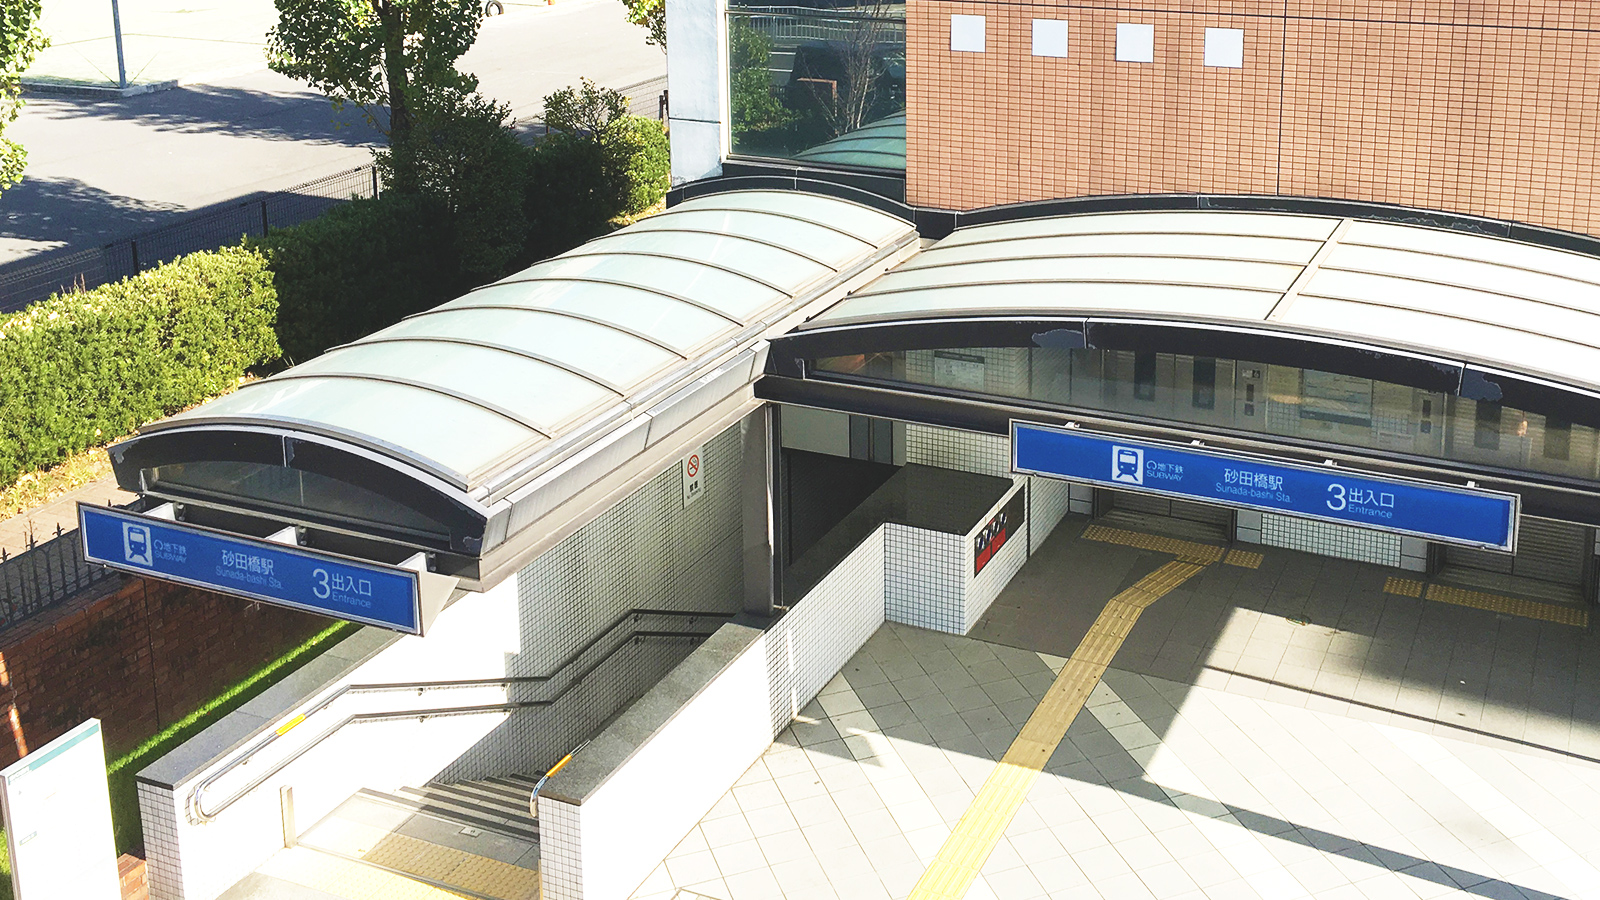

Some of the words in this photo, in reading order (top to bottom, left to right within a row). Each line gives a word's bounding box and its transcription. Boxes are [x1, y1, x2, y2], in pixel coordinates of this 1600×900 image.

[1146, 470, 1183, 481] SUBWAY
[1157, 462, 1184, 475] 地下鉄
[1224, 468, 1283, 491] 砂田橋駅
[1215, 482, 1274, 499] Sunada-bashi
[1275, 491, 1292, 503] Sta.
[1326, 483, 1347, 511] 3
[1348, 487, 1395, 509] 出入口
[1348, 503, 1393, 519] Entrance
[154, 551, 187, 564] SUBWAY
[163, 543, 187, 557] 地下鉄
[221, 549, 274, 576] 砂田橋駅
[215, 566, 267, 586] Sunada-bashi
[268, 576, 284, 589] Sta.
[312, 568, 331, 599] 3
[331, 572, 372, 597] 出入口
[331, 591, 372, 608] Entrance
